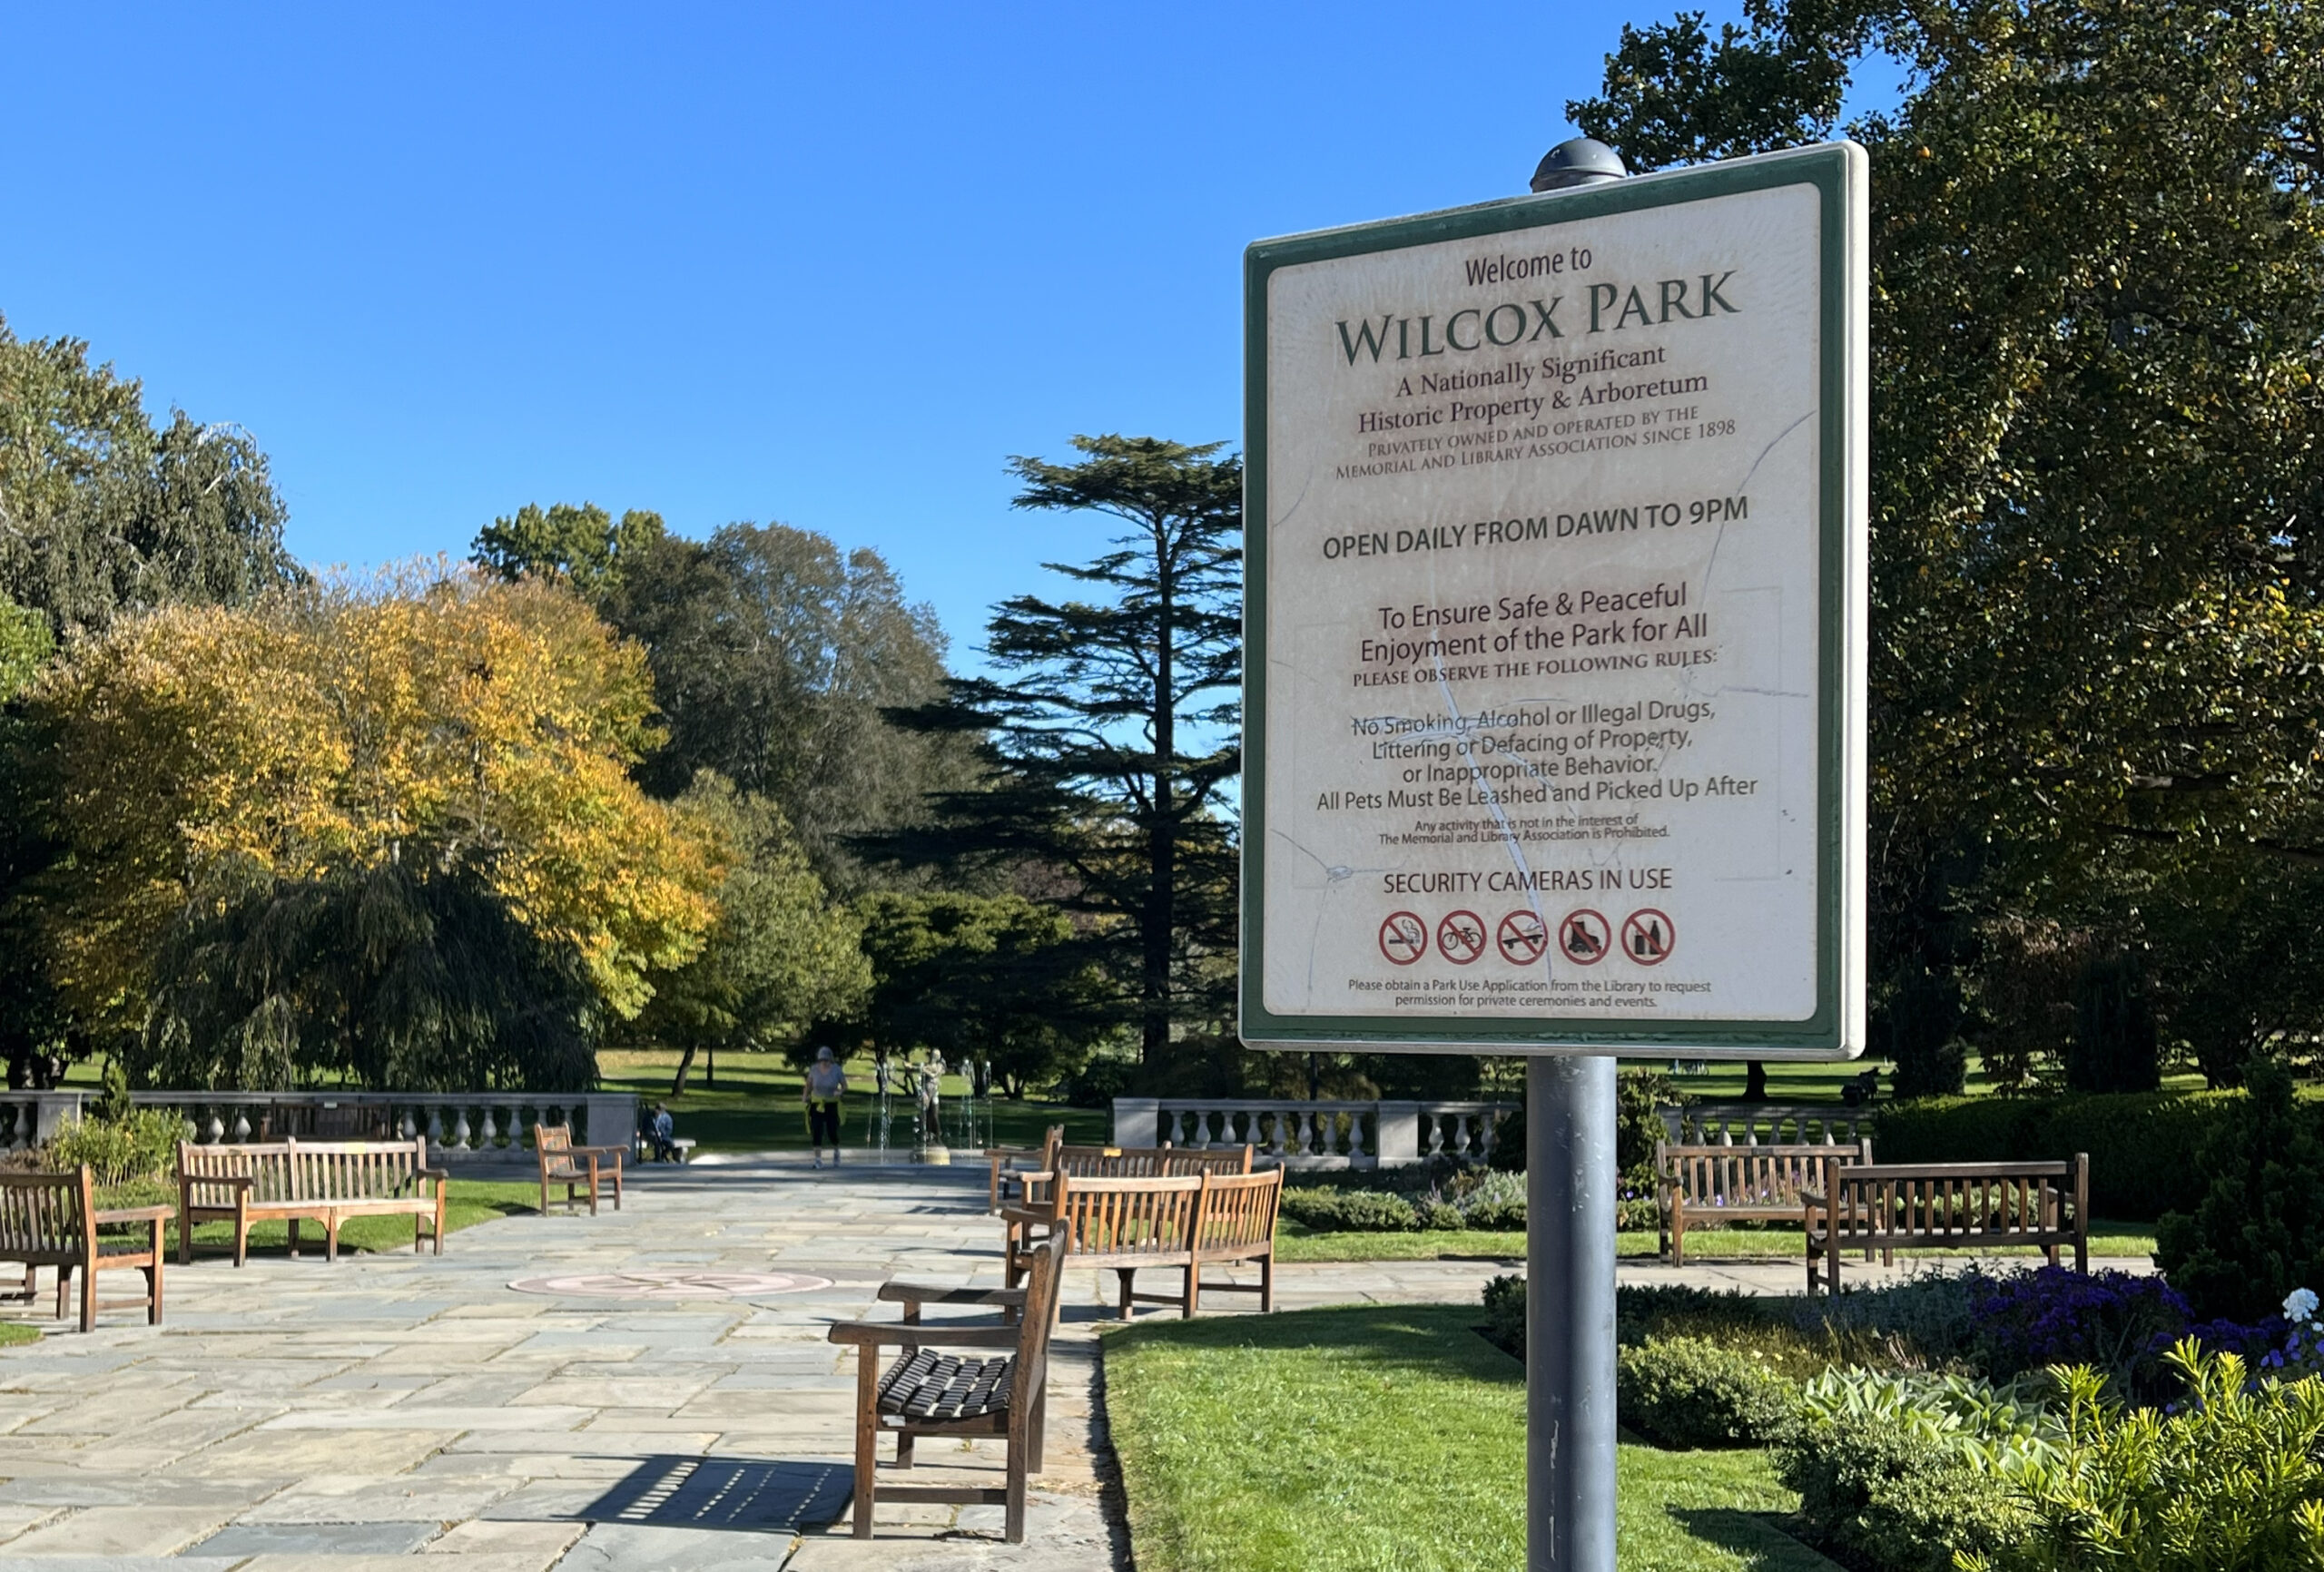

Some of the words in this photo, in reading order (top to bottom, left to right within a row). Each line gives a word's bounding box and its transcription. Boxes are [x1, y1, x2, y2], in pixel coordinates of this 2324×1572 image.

[1466, 252, 1563, 287] Welcome
[1571, 248, 1592, 270] to
[1335, 296, 1565, 367] WILCOX
[1587, 270, 1741, 333] PARK
[1396, 378, 1413, 398] A
[1421, 363, 1536, 396] Nationally
[1541, 345, 1667, 383] Significant
[1358, 406, 1443, 434] Historic
[1450, 394, 1544, 426] Property
[1551, 389, 1571, 409] &
[1578, 374, 1709, 407] Arboretum
[1335, 459, 1417, 480] MEMORIAL
[1422, 454, 1455, 470] AND
[1462, 446, 1523, 467] LIBRARY
[1528, 432, 1638, 458] ASSOCIATION
[1642, 425, 1692, 445] SINCE
[1698, 419, 1736, 439] 1898
[1368, 437, 1443, 457] PRIVATELY
[1448, 429, 1509, 448] OWNED
[1513, 424, 1549, 441] AND
[1553, 413, 1636, 437] OPERATED
[1641, 410, 1663, 427] BY
[1666, 405, 1699, 422] THE
[1323, 533, 1388, 559] OPEN
[1397, 525, 1467, 552] DAILY
[1474, 516, 1548, 545] FROM
[1557, 507, 1637, 537] DAWN
[1644, 503, 1681, 528] TO
[1689, 496, 1748, 525] 9PM
[1378, 607, 1405, 630] To
[1413, 600, 1491, 627] Ensure
[1498, 593, 1549, 620] Safe
[1555, 594, 1573, 615] &
[1581, 582, 1687, 614] Peaceful
[1362, 634, 1486, 665] Enjoyment
[1493, 627, 1521, 652] of
[1524, 627, 1564, 649] the
[1572, 621, 1625, 646] Park
[1632, 618, 1667, 642] for
[1675, 614, 1708, 639] All
[1354, 669, 1409, 687] PLEASE
[1413, 663, 1488, 683] OBSERVE
[1494, 662, 1531, 677] THE
[1536, 653, 1648, 675] FOLLOWING
[1656, 648, 1718, 666] RULES:
[1354, 718, 1380, 736] No
[1384, 713, 1472, 734] Smoking,
[1477, 706, 1550, 730] Alcohol
[1555, 710, 1578, 724] or
[1582, 703, 1642, 727] Illegal
[1649, 701, 1716, 723] Drugs,
[1373, 740, 1451, 761] Littering
[1456, 740, 1480, 755] or
[1482, 732, 1568, 756] Defacing
[1573, 731, 1596, 750] of
[1600, 728, 1692, 753] Property,
[1403, 768, 1423, 783] or
[1427, 760, 1560, 785] Inappropriate
[1565, 754, 1658, 775] Behavior.
[1317, 793, 1340, 811] All
[1345, 791, 1383, 810] Pets
[1387, 790, 1433, 808] Must
[1439, 788, 1462, 806] Be
[1467, 784, 1546, 804] Leashed
[1553, 784, 1590, 802] and
[1597, 781, 1661, 800] Picked
[1669, 778, 1699, 801] Up
[1705, 775, 1758, 796] After
[1379, 833, 1399, 844] The
[1402, 831, 1453, 844] Memorial
[1457, 831, 1478, 842] and
[1481, 830, 1520, 844] Library
[1522, 828, 1590, 840] Association
[1592, 828, 1601, 839] is
[1604, 826, 1670, 839] Prohibited.
[1415, 820, 1437, 832] Any
[1439, 819, 1480, 831] activity
[1482, 818, 1505, 829] that
[1508, 818, 1518, 828] is
[1520, 819, 1540, 829] not
[1542, 817, 1553, 828] in
[1555, 816, 1576, 827] the
[1579, 815, 1622, 827] interest
[1625, 814, 1639, 825] of
[1384, 871, 1482, 894] SECURITY
[1488, 870, 1594, 892] CAMERAS
[1600, 870, 1622, 889] IN
[1629, 868, 1673, 889] USE
[1349, 978, 1383, 991] Please
[1384, 978, 1421, 991] obtain
[1423, 982, 1430, 991] a
[1433, 979, 1456, 990] Park
[1459, 979, 1481, 991] Use
[1482, 978, 1548, 993] Application
[1551, 979, 1580, 991] from
[1583, 979, 1602, 991] the
[1604, 979, 1646, 994] Library
[1649, 981, 1661, 992] to
[1664, 981, 1711, 995] request
[1395, 995, 1455, 1007] permission
[1459, 994, 1474, 1006] for
[1477, 995, 1516, 1007] private
[1519, 995, 1585, 1007] ceremonies
[1589, 996, 1612, 1007] and
[1615, 997, 1657, 1007] events.
